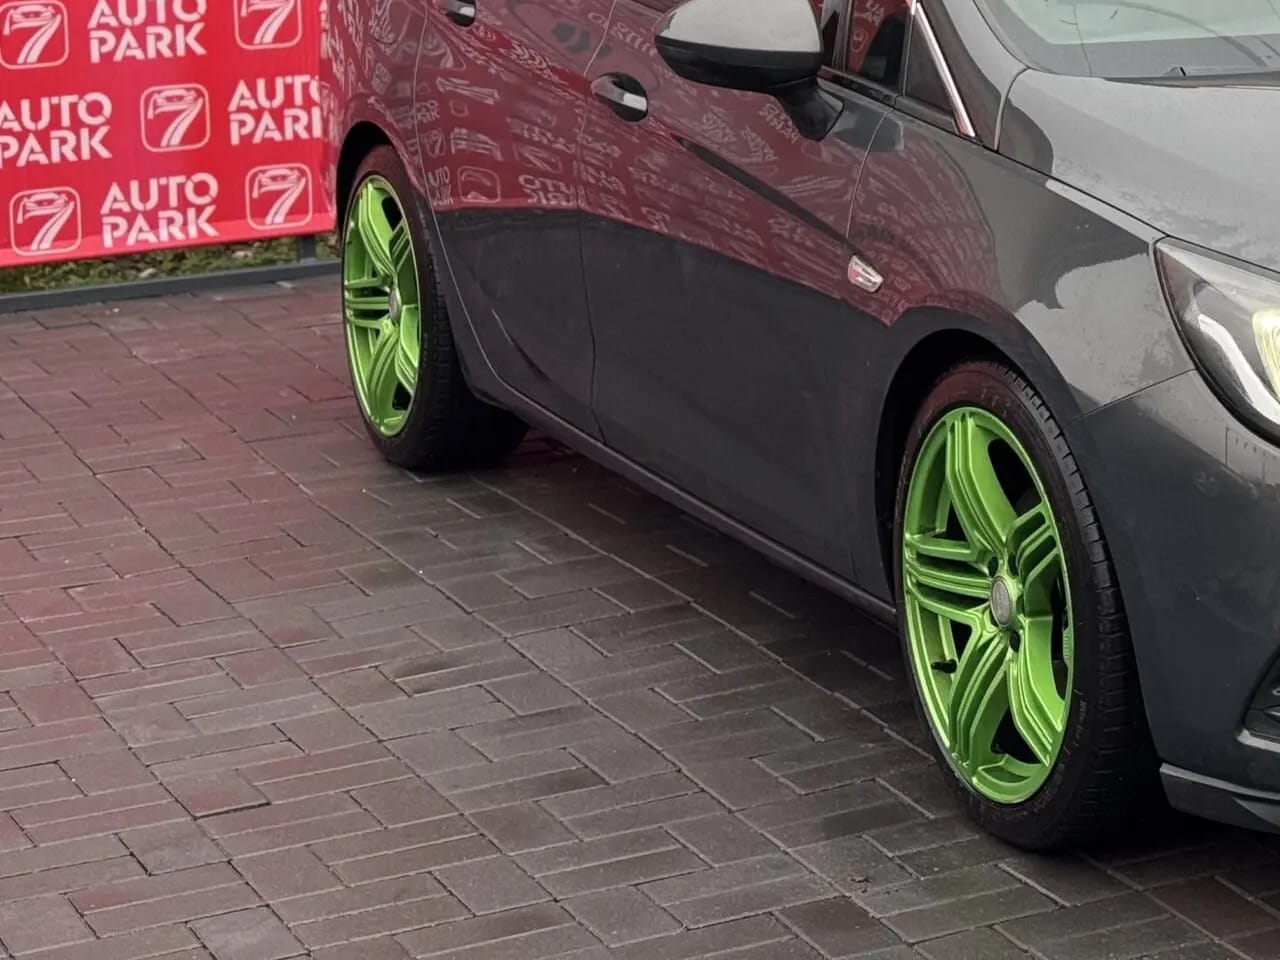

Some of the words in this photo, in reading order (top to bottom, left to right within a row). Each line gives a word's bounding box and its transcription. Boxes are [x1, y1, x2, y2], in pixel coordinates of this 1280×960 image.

[89, 22, 206, 63] PARK
[0, 91, 112, 133] AUTO
[0, 124, 112, 168] PARK
[100, 171, 219, 215] AUTO
[102, 205, 219, 249] PARK
